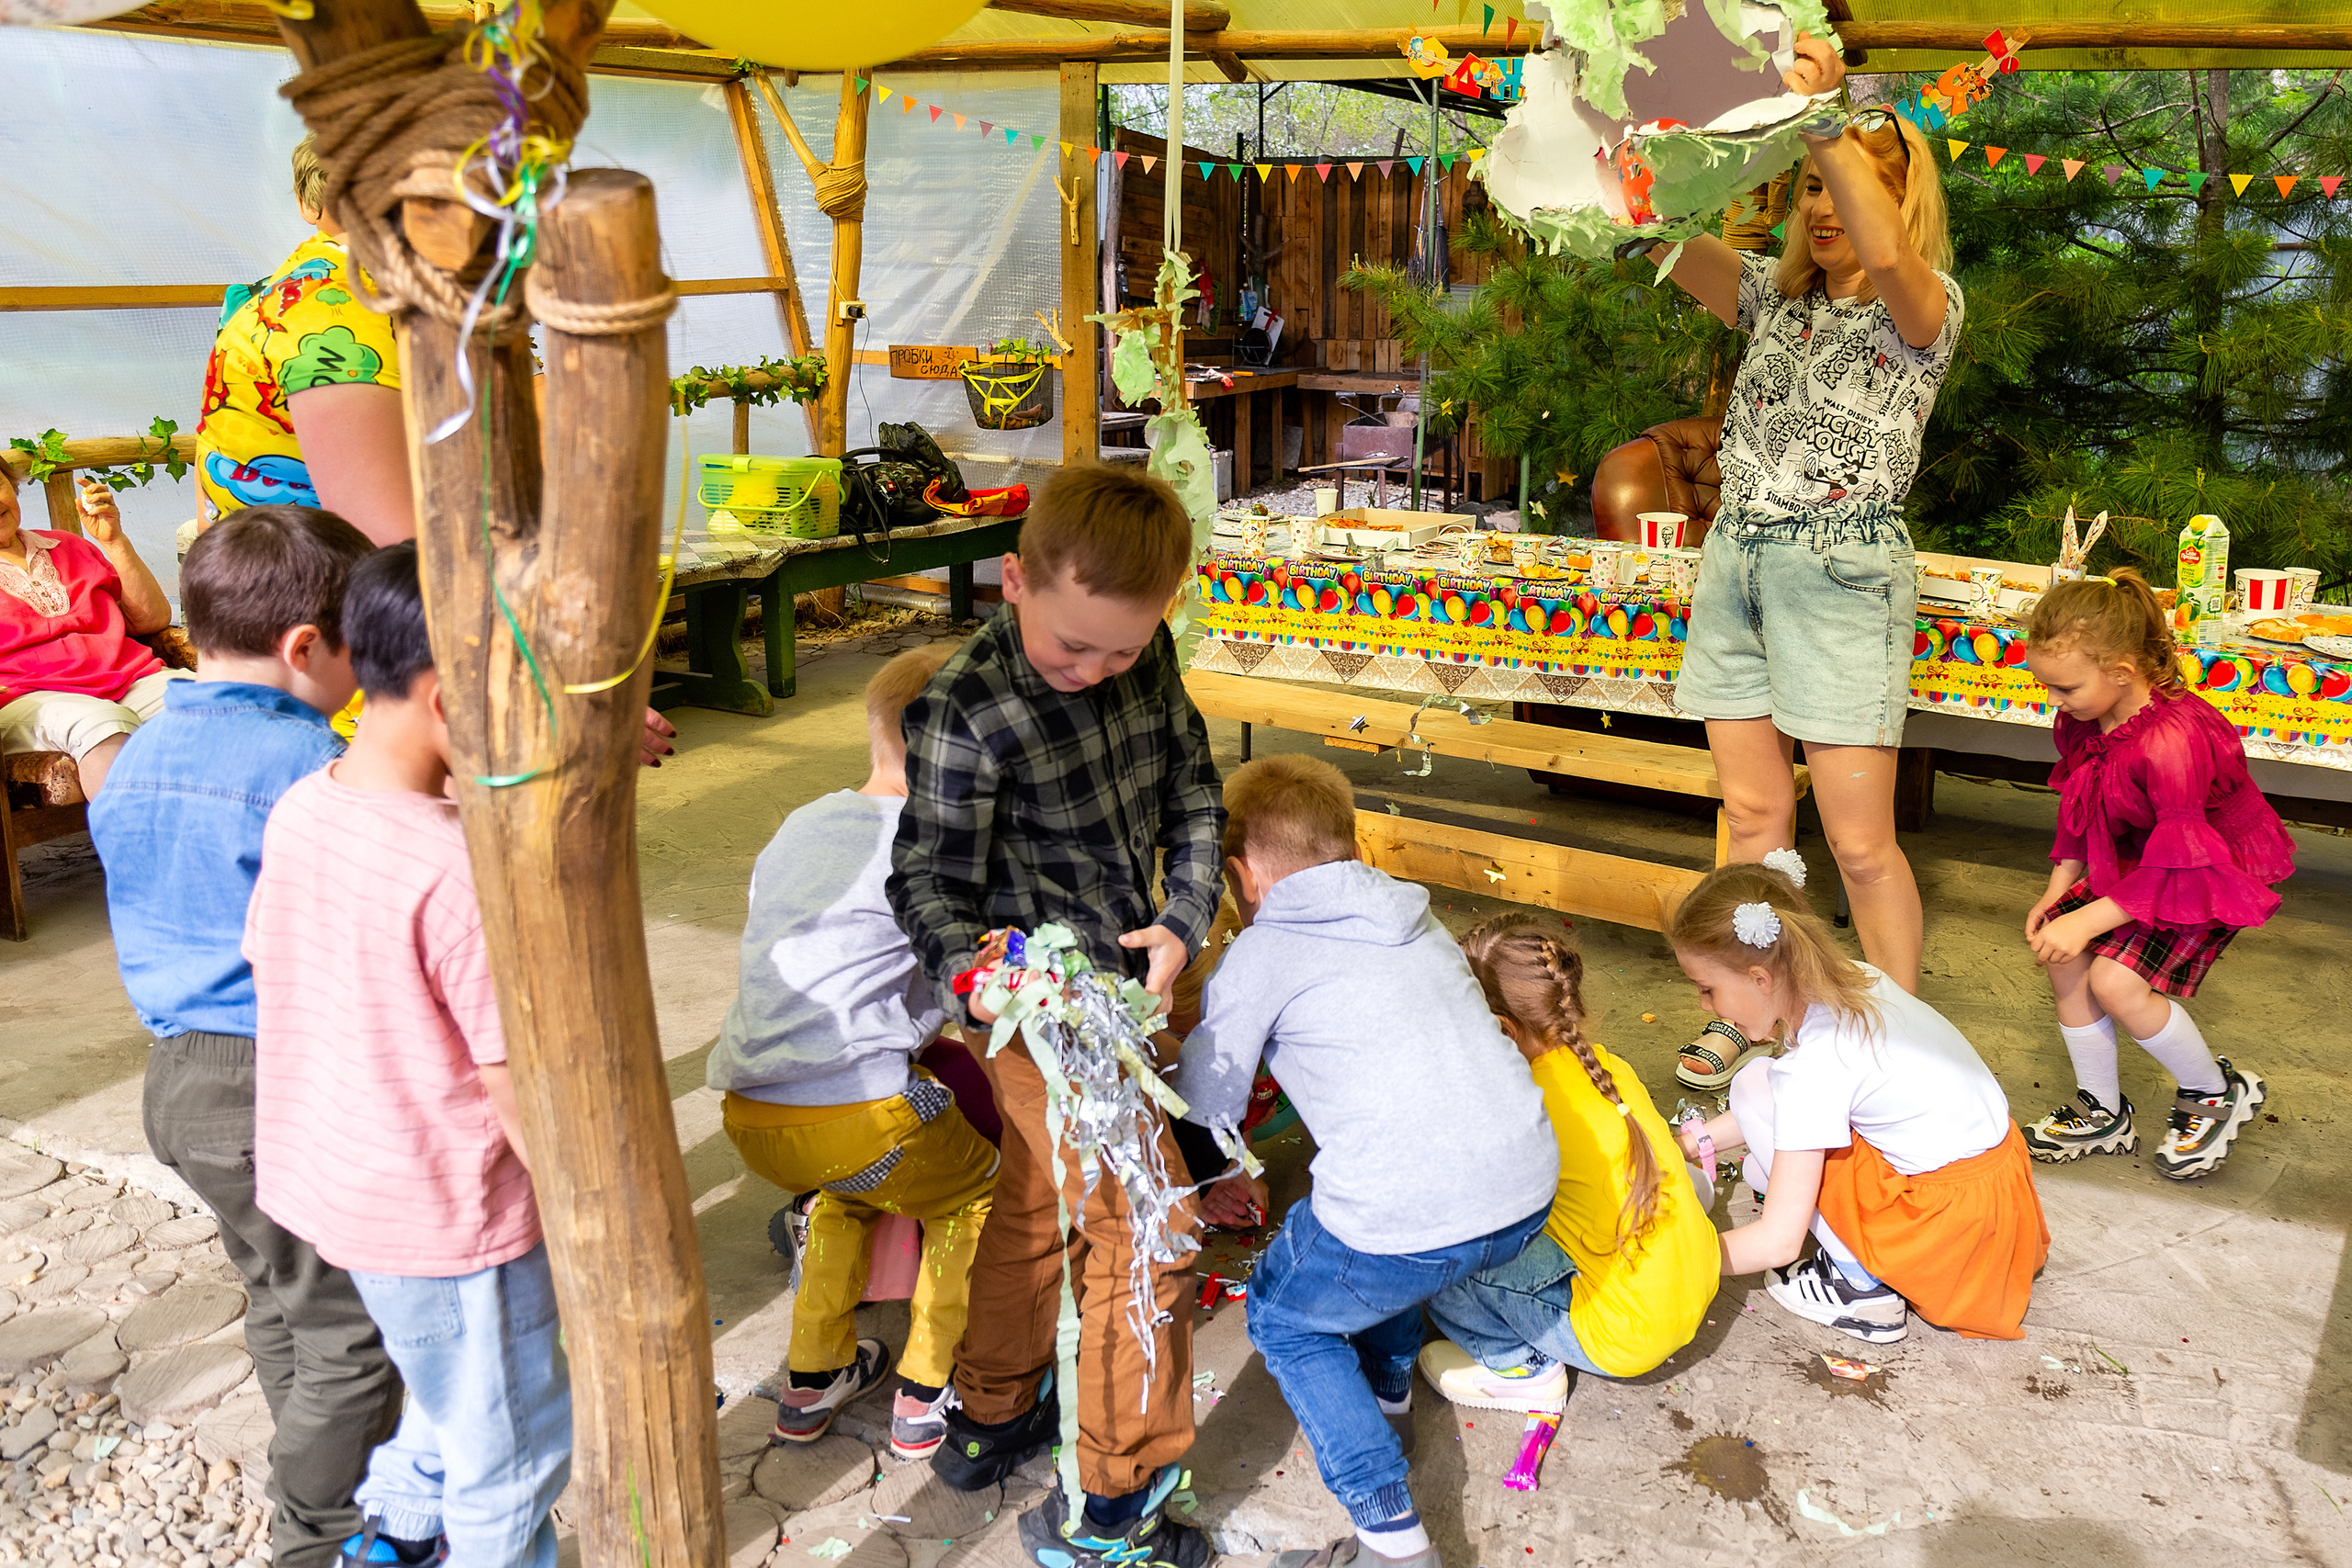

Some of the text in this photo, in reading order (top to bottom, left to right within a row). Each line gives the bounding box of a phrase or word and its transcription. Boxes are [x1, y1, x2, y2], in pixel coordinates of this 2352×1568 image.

[890, 349, 933, 368] ПРОБКИ
[921, 365, 958, 378] СЮДА
[1823, 397, 1846, 412] WALT
[1805, 401, 1883, 448] MICKEY
[1737, 421, 1782, 483] ICKEY MOUSE
[1794, 419, 1879, 470] MOUSE
[1764, 491, 1808, 513] STEAMBO
[1218, 557, 1265, 574] BIRTHDAY
[1288, 563, 1338, 581] BIRTHDAY
[1362, 570, 1413, 587] BIRTHDAY
[1438, 575, 1492, 594] BIRTHDAY
[1517, 582, 1573, 602] BRTHDAY
